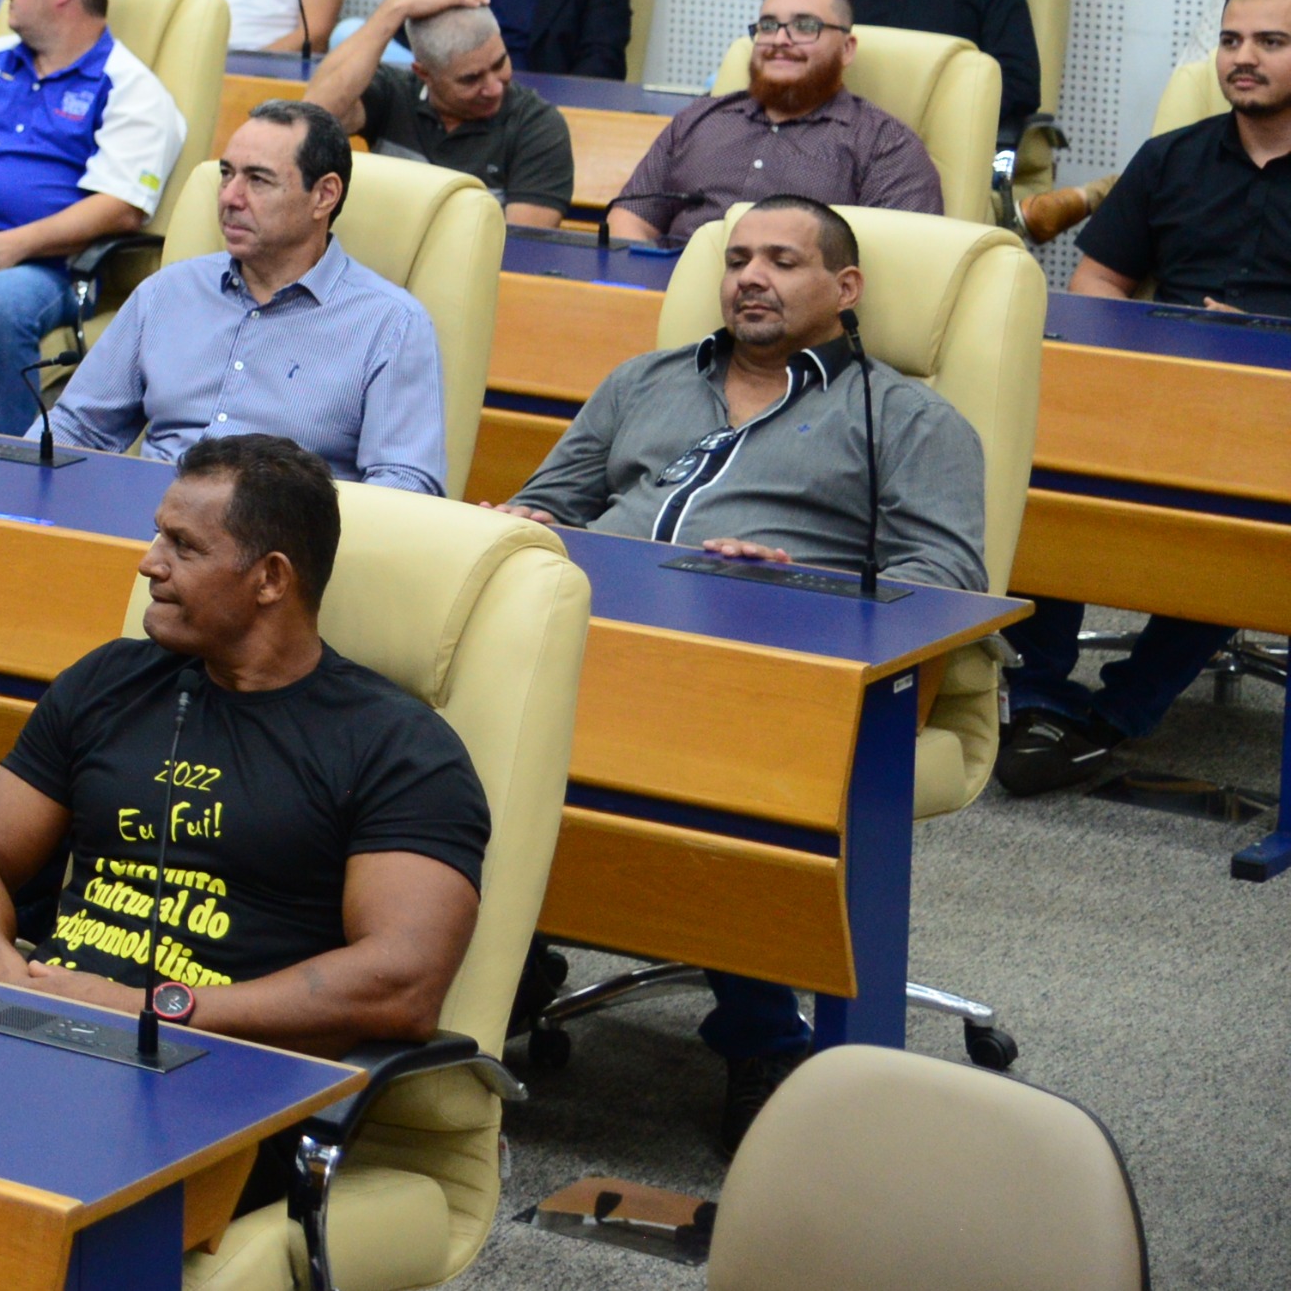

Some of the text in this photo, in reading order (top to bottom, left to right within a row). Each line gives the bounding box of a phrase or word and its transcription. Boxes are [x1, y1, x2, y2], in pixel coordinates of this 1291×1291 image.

[154, 759, 221, 791] 2022
[118, 801, 223, 842] Eu Fui!
[84, 876, 189, 927] Cultural
[187, 898, 230, 939] do
